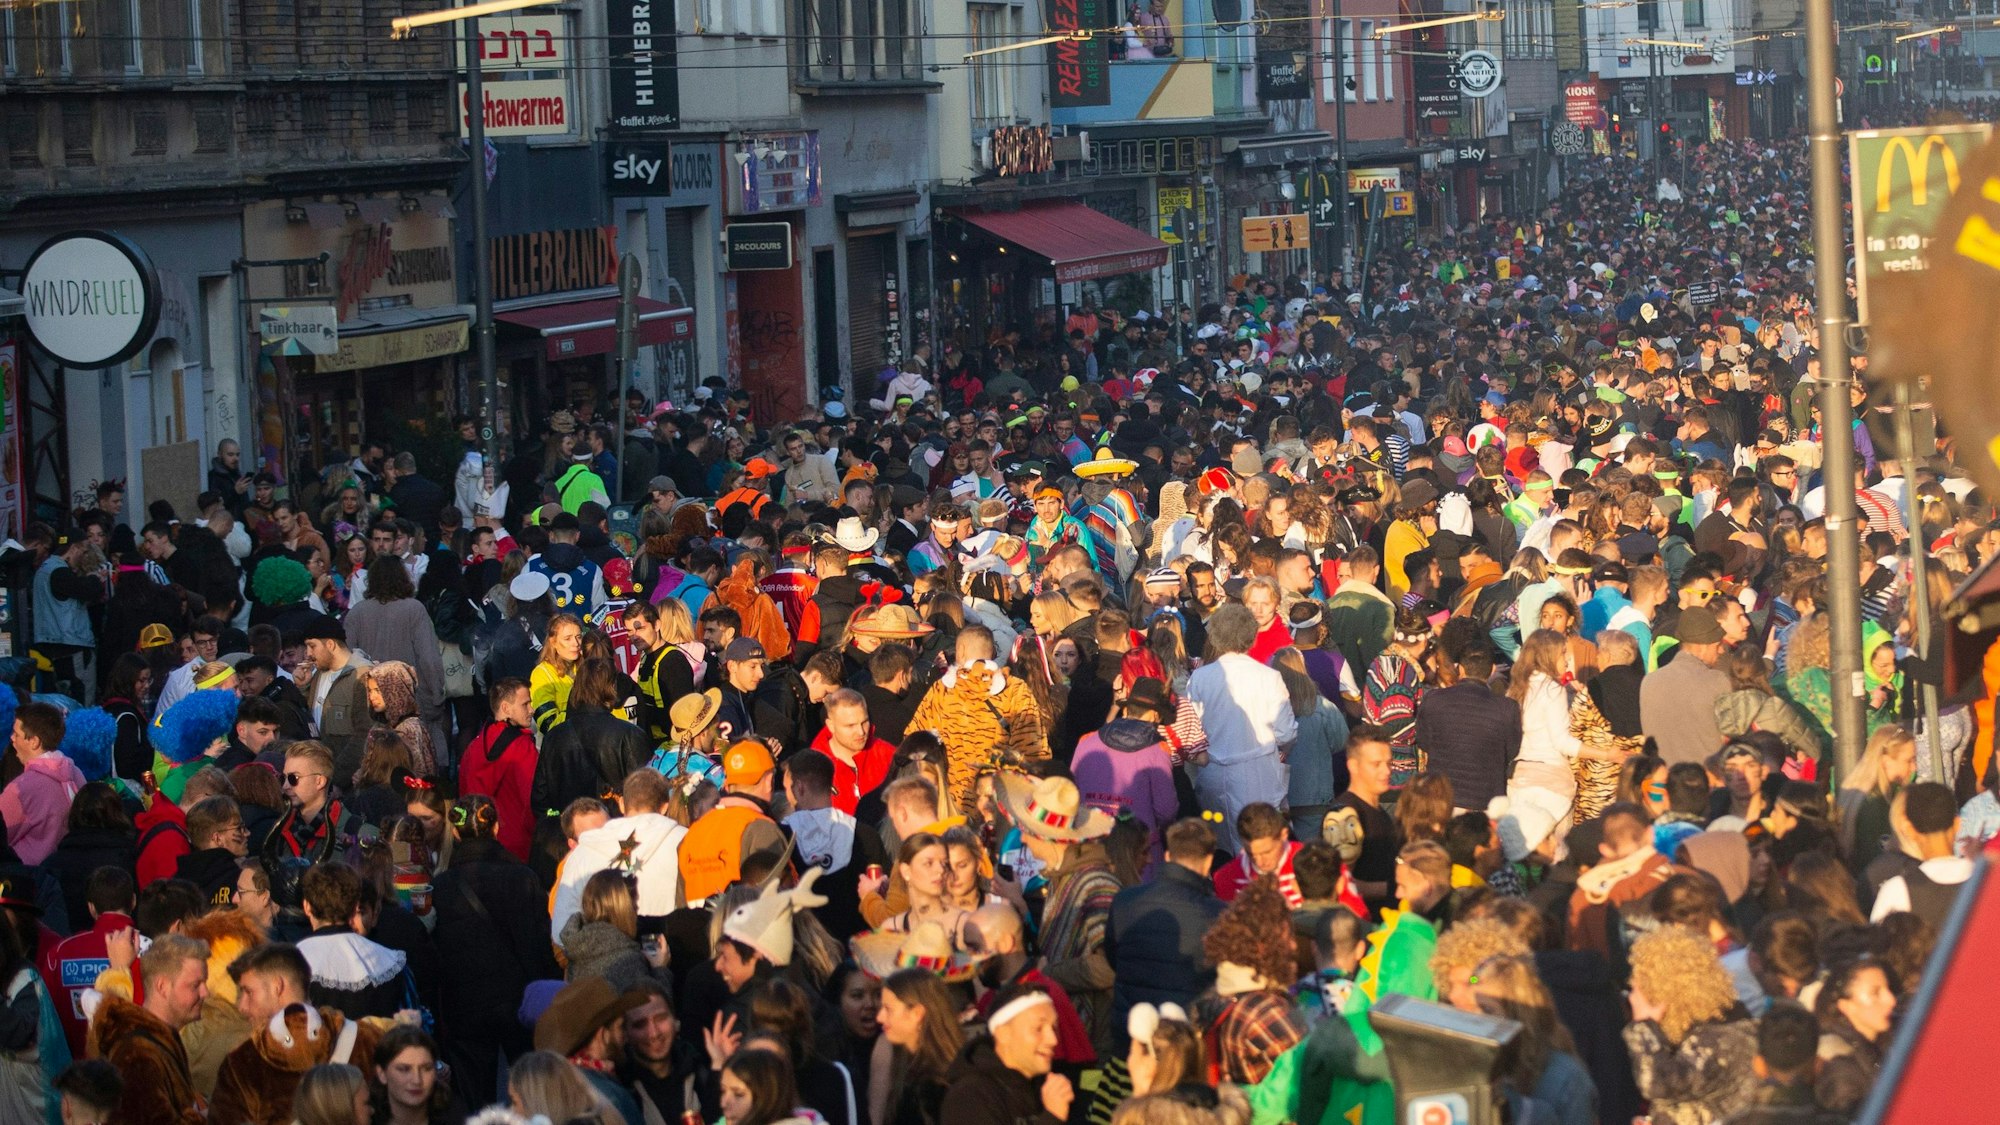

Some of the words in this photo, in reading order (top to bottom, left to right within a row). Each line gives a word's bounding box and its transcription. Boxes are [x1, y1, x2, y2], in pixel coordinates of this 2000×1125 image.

[1565, 86, 1596, 97] KIOSK
[463, 89, 565, 129] Shawarma
[620, 115, 645, 127] Gaffel
[1460, 146, 1486, 161] sky
[613, 153, 662, 185] sky
[1359, 179, 1397, 190] KISK
[734, 241, 782, 251] 24COLOURS
[1867, 236, 1886, 252] in
[1889, 234, 1921, 250] 100
[1883, 256, 1930, 272] rech
[28, 279, 140, 317] WNDRFUEL
[268, 321, 323, 335] tinkhaar
[552, 572, 574, 606] 3
